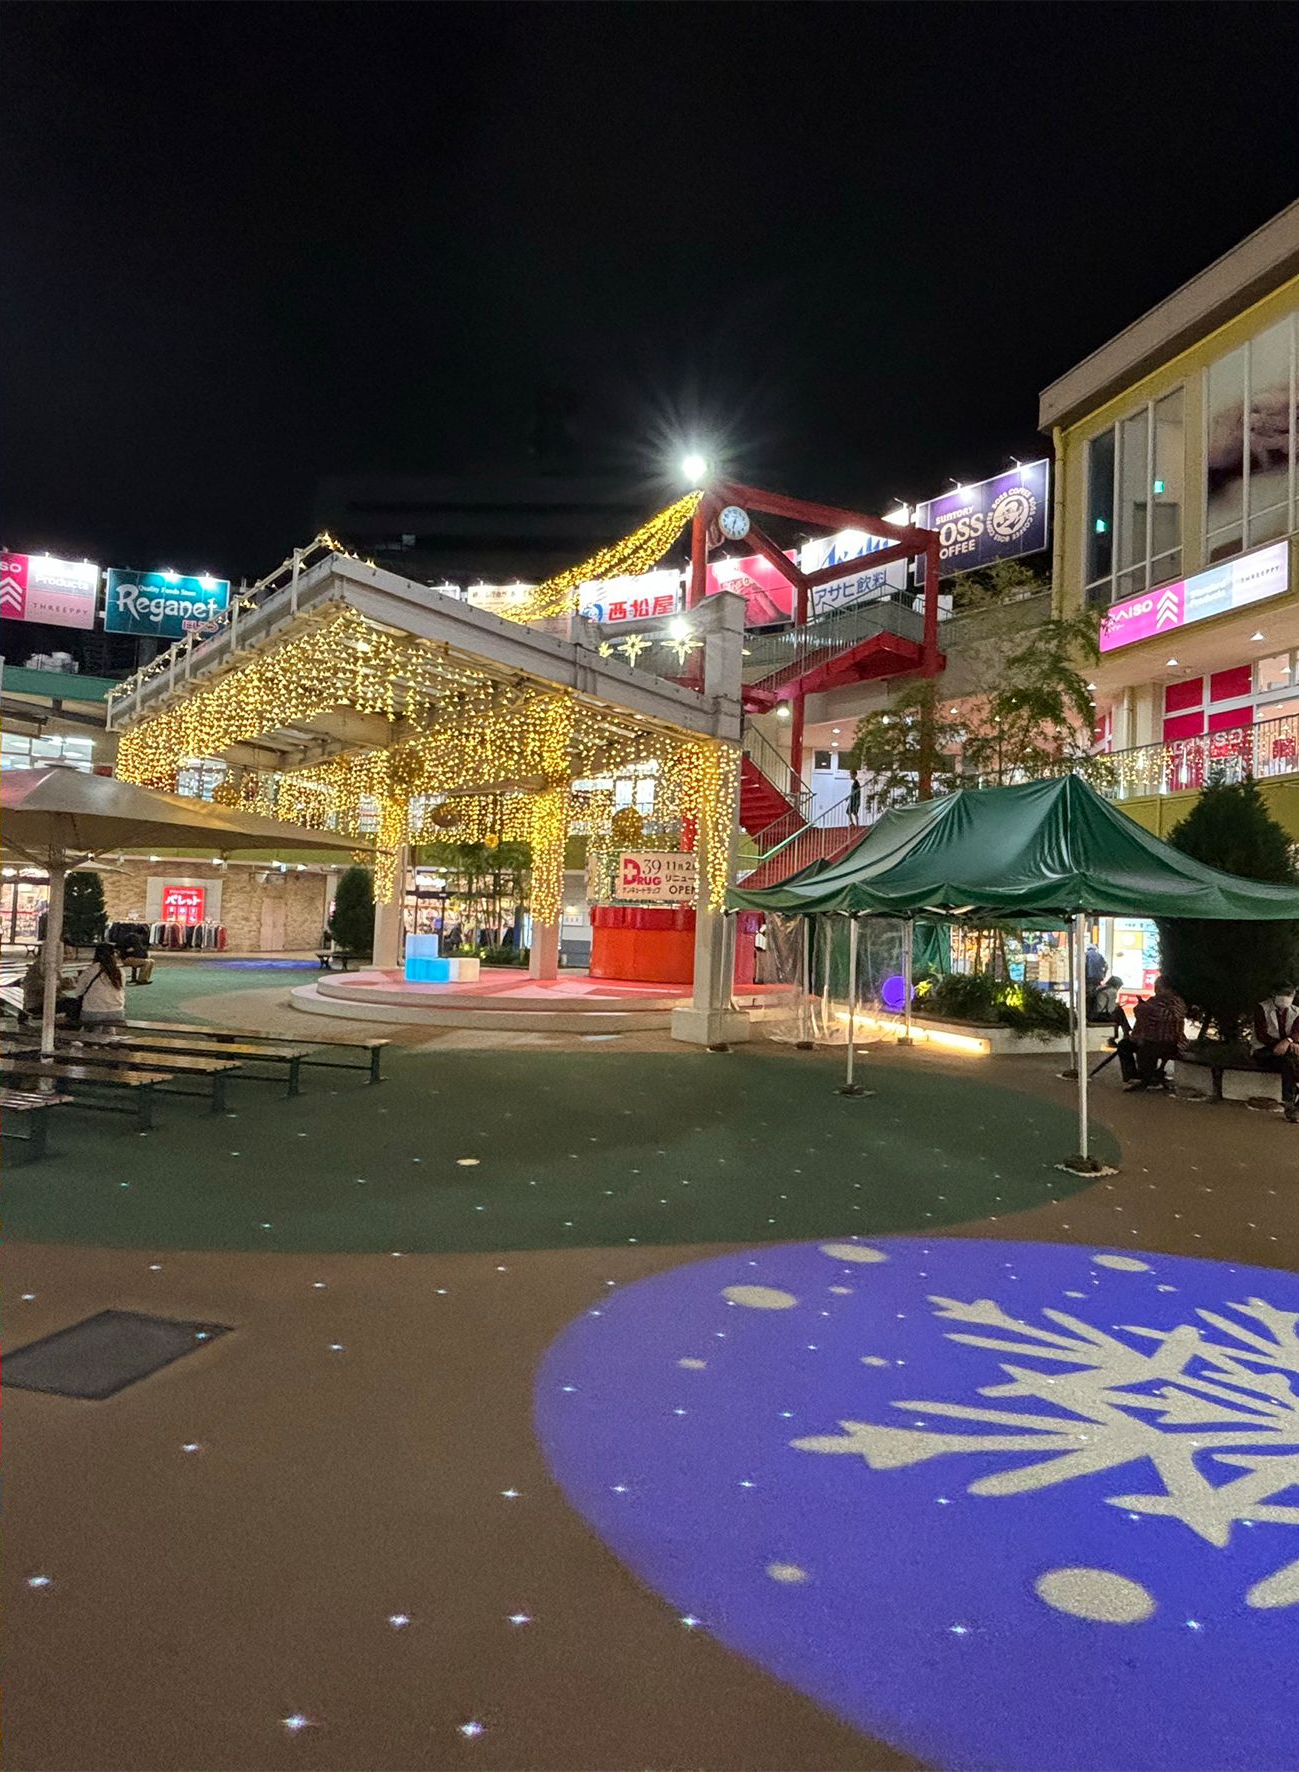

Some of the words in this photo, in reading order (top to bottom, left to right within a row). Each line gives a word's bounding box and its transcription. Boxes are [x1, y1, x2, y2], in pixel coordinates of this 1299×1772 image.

[935, 505, 975, 525] SUNTORY
[937, 513, 984, 547] OSS
[939, 539, 976, 560] OFFEE
[1240, 564, 1280, 584] THREEPPY
[138, 585, 160, 593] Quality
[161, 587, 179, 595] Foods
[815, 570, 887, 606] アサヒ飲料
[33, 602, 89, 615] THREEPPY
[116, 583, 218, 622] Reganet
[608, 595, 674, 621] 西松屋
[623, 859, 661, 885] DRUG
[642, 859, 661, 875] 39
[164, 894, 202, 906] パレット
